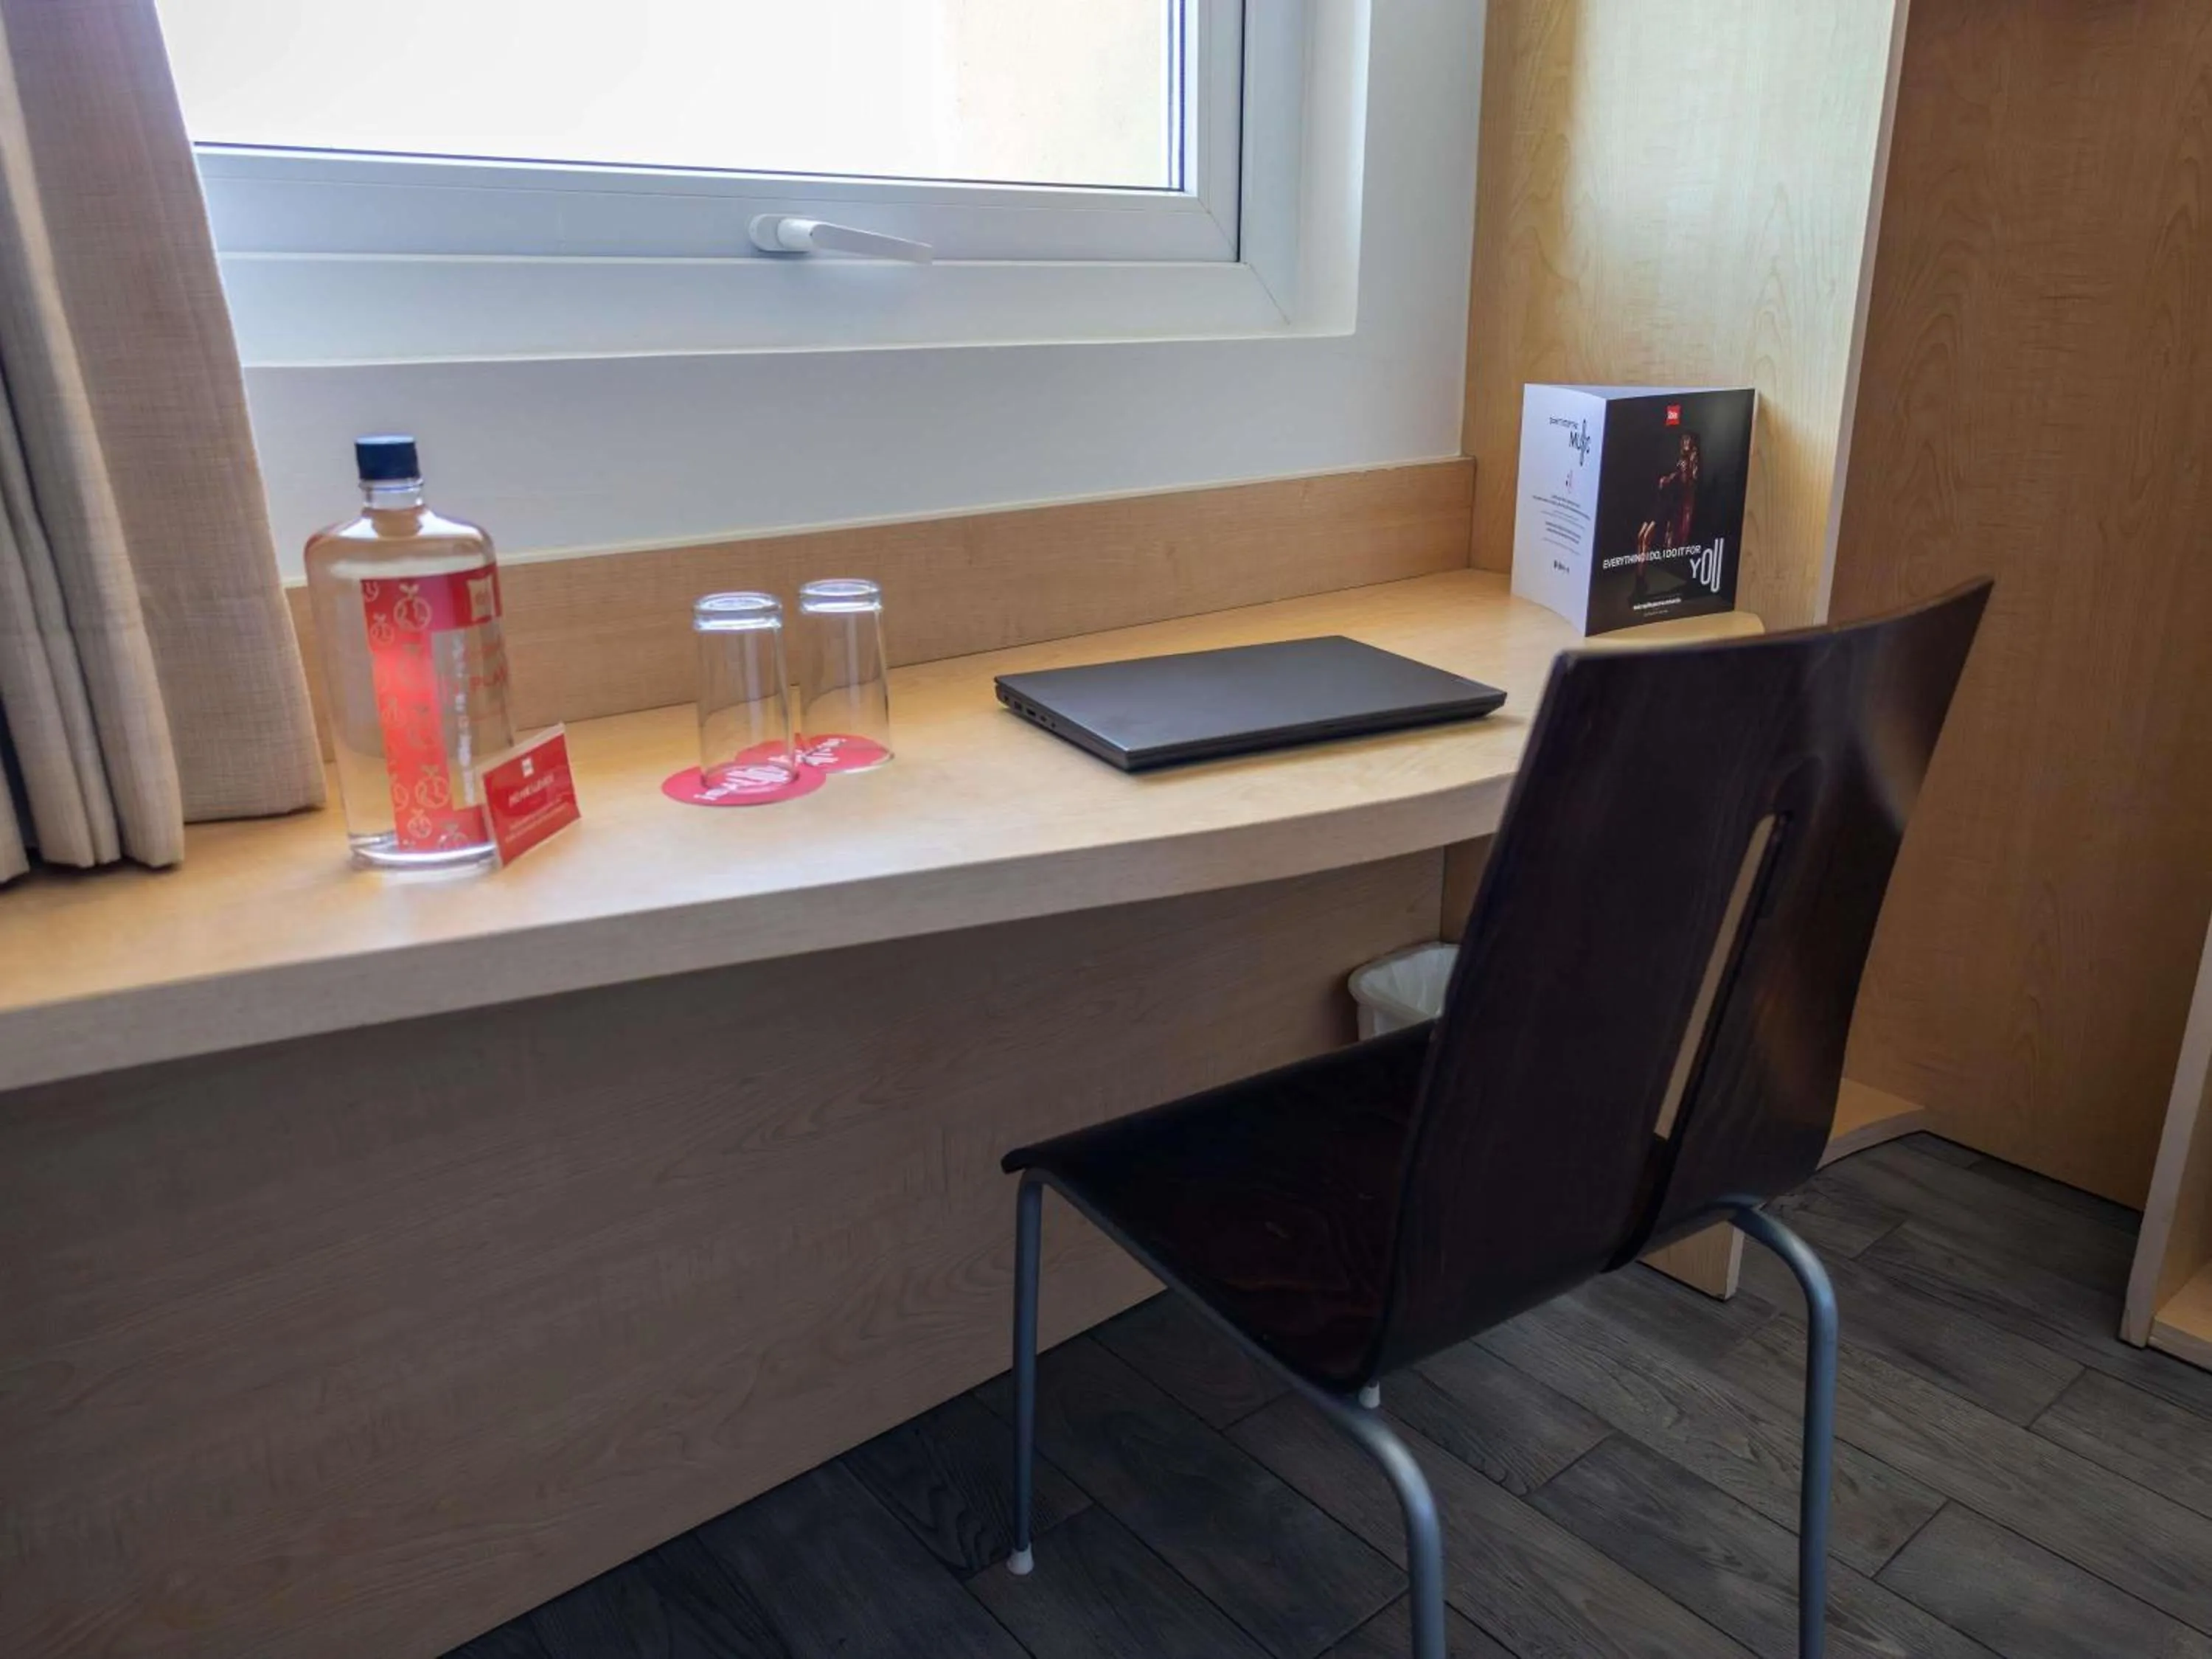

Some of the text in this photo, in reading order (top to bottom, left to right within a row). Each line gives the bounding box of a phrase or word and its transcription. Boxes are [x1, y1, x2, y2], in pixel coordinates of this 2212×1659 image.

[1602, 553, 1646, 570] EVERYTHING
[1666, 548, 1677, 558] DO
[1677, 546, 1686, 556] IT
[1686, 545, 1702, 554] FOR
[1689, 538, 1725, 593] YOU
